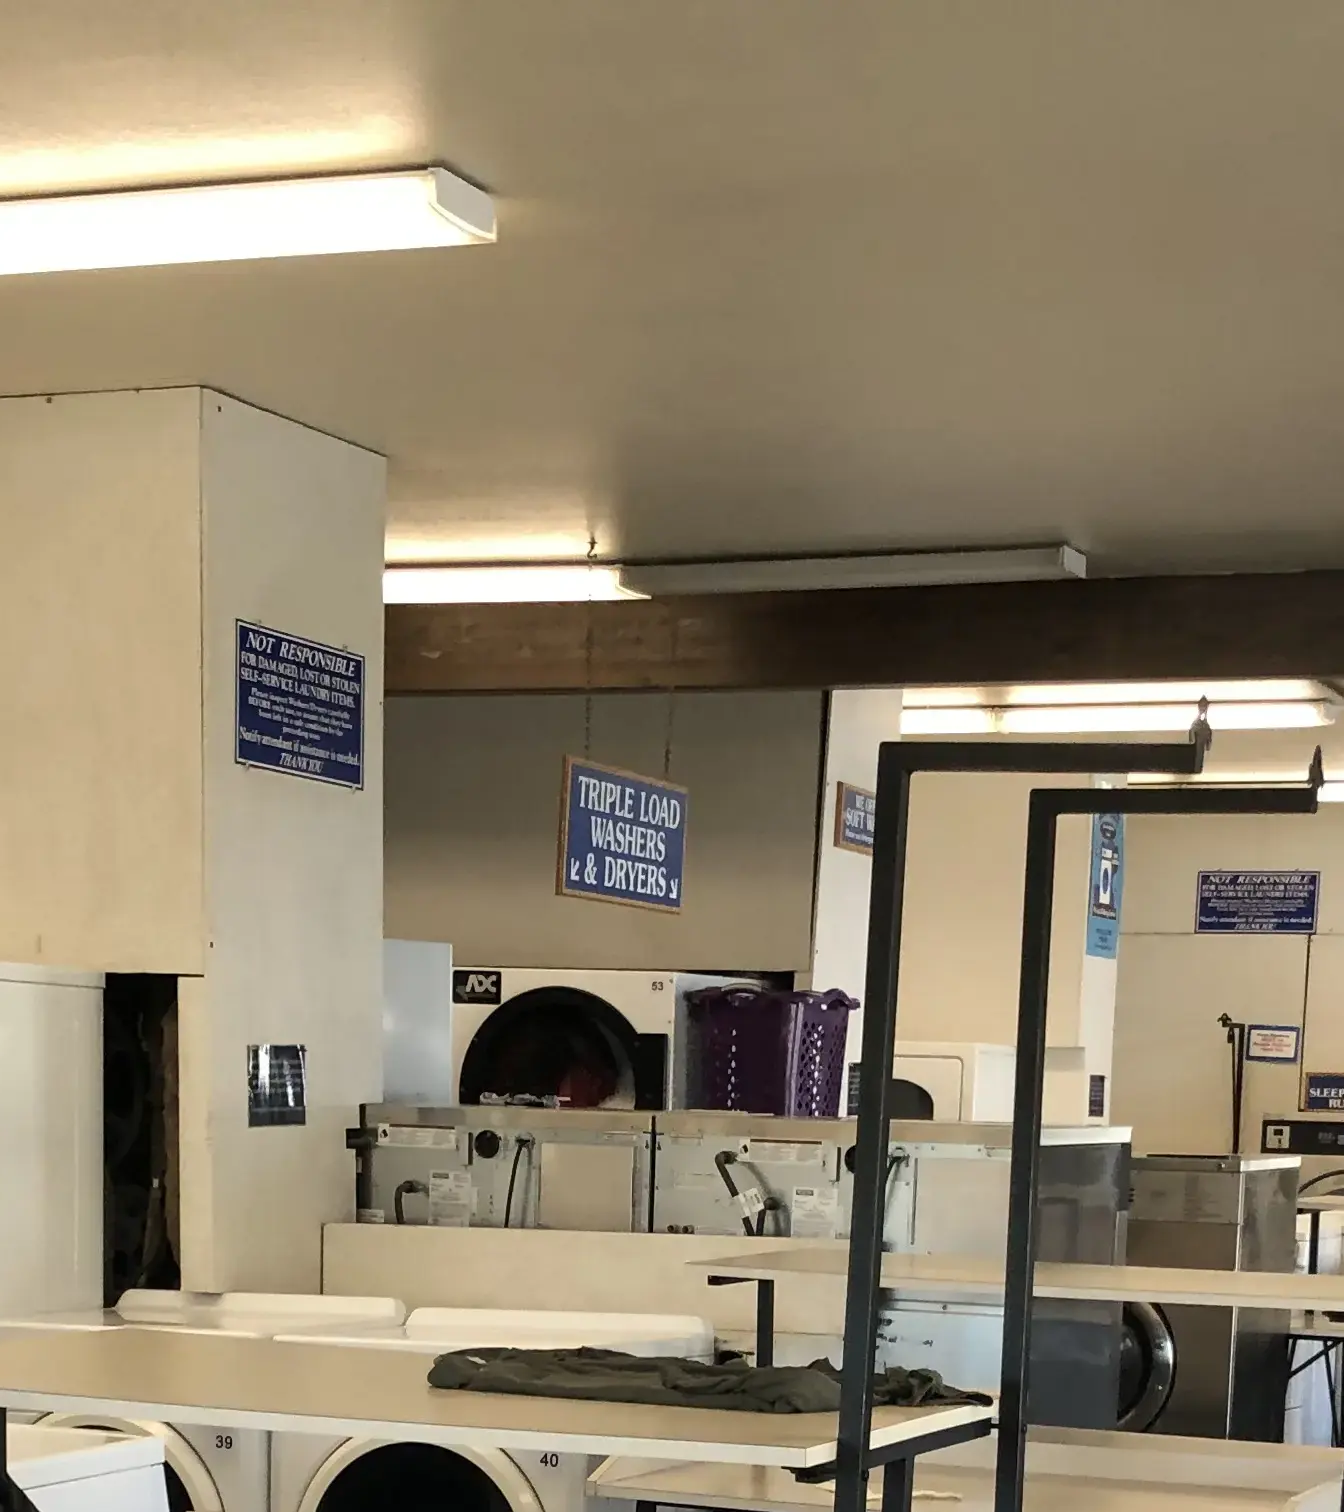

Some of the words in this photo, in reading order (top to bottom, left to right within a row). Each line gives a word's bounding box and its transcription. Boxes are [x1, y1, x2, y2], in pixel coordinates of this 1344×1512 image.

[246, 632, 275, 653] NOT
[279, 642, 356, 676] RESPONSIBLE
[241, 652, 256, 666] FOR
[300, 669, 320, 684] LOST
[320, 673, 330, 686] OR
[332, 677, 360, 694] STOLEN
[241, 668, 293, 692] SELF-SERVICE
[295, 681, 330, 701] LAUNDRY
[240, 726, 261, 745] Notify
[279, 753, 308, 770] THANK
[578, 775, 635, 819] TRIPLE
[639, 791, 681, 829] LOAD
[846, 807, 865, 829] SOFT
[591, 816, 666, 862] WASHERS
[584, 853, 598, 885] &
[604, 856, 667, 897] DRYERS
[1237, 875, 1311, 883] RESPONSIBLE
[465, 974, 497, 993] ADC
[651, 981, 664, 991] 53
[215, 1434, 233, 1449] 39
[539, 1452, 559, 1467] 40
